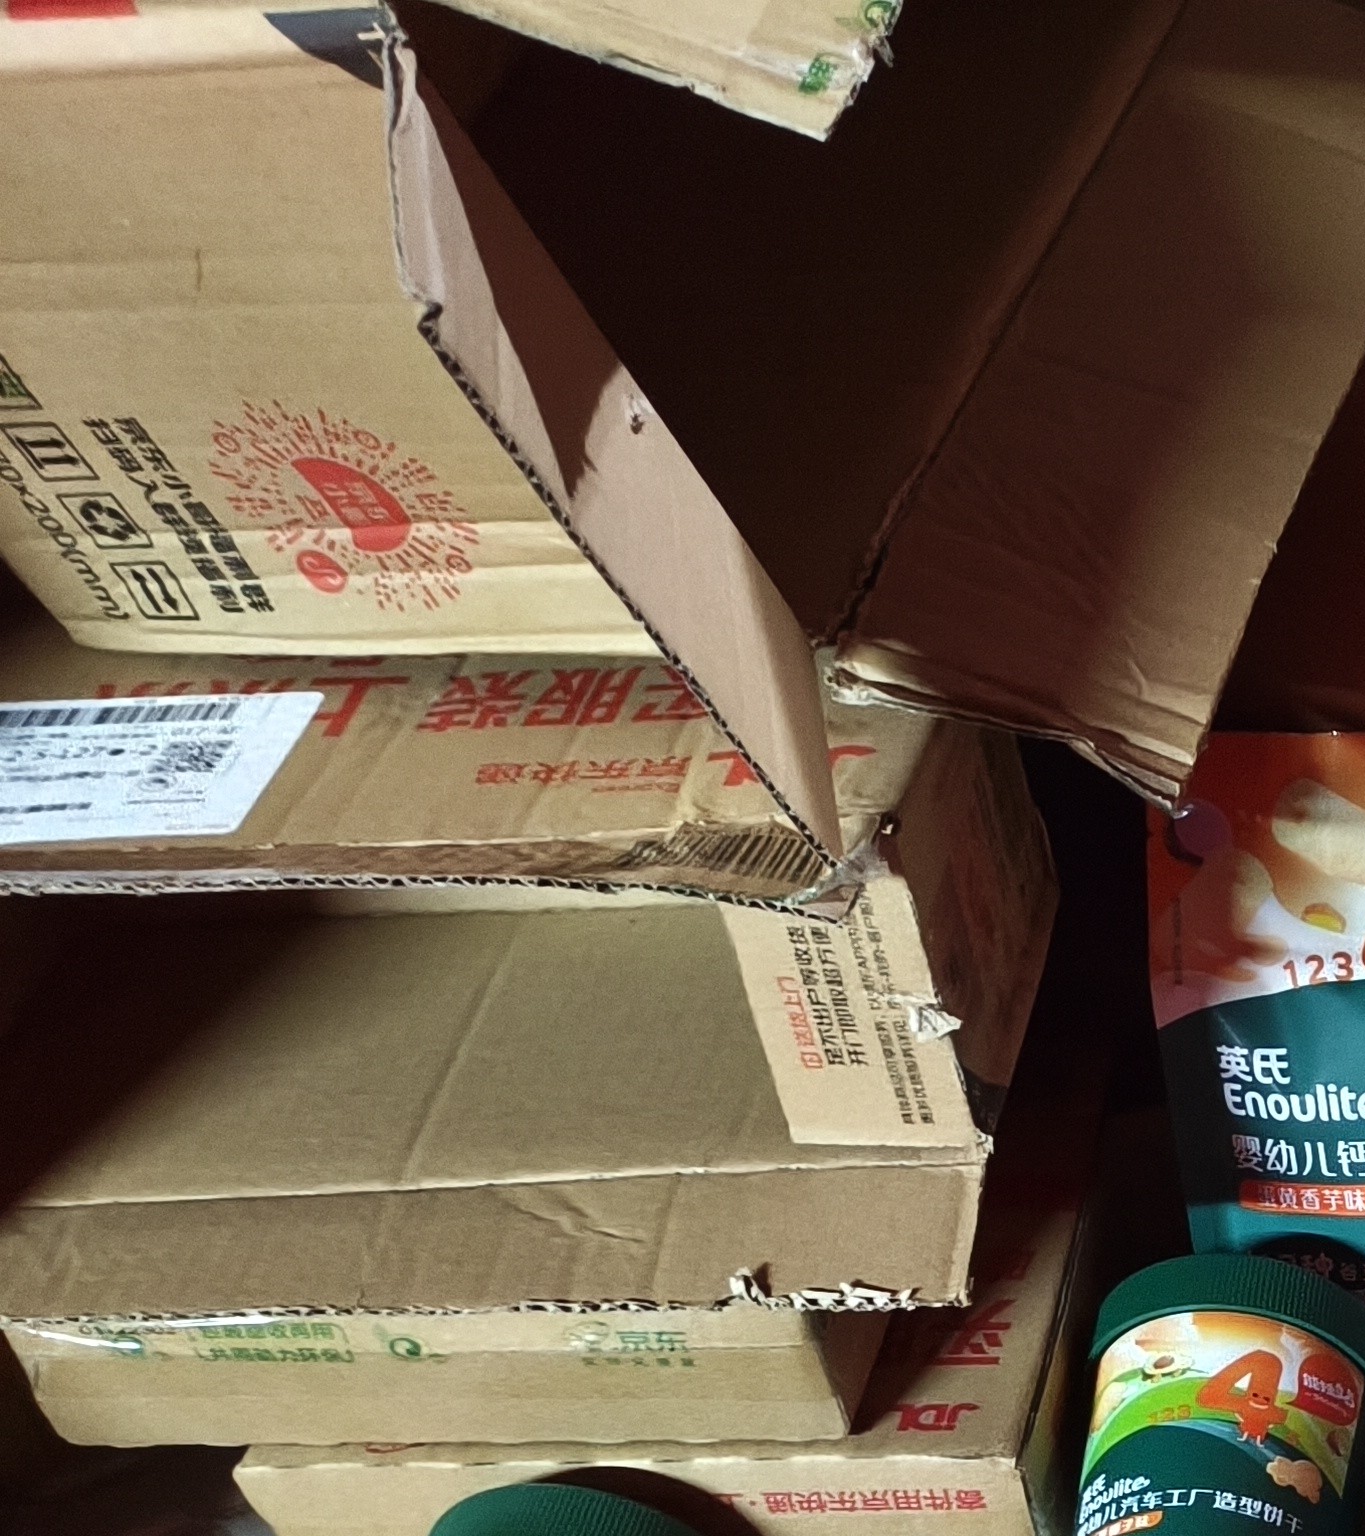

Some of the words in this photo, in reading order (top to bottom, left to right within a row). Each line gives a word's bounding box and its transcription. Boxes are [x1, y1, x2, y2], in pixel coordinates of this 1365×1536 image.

[810, 926, 870, 1067] 开门即取超方便
[1282, 959, 1299, 988] 1
[1308, 954, 1329, 983] 2
[1332, 951, 1355, 981] 3
[776, 975, 816, 1045] 送货上门
[1216, 1045, 1291, 1086] 英氏
[1196, 1348, 1291, 1448] 4
[763, 1488, 987, 1514] 寄件用京东快递
